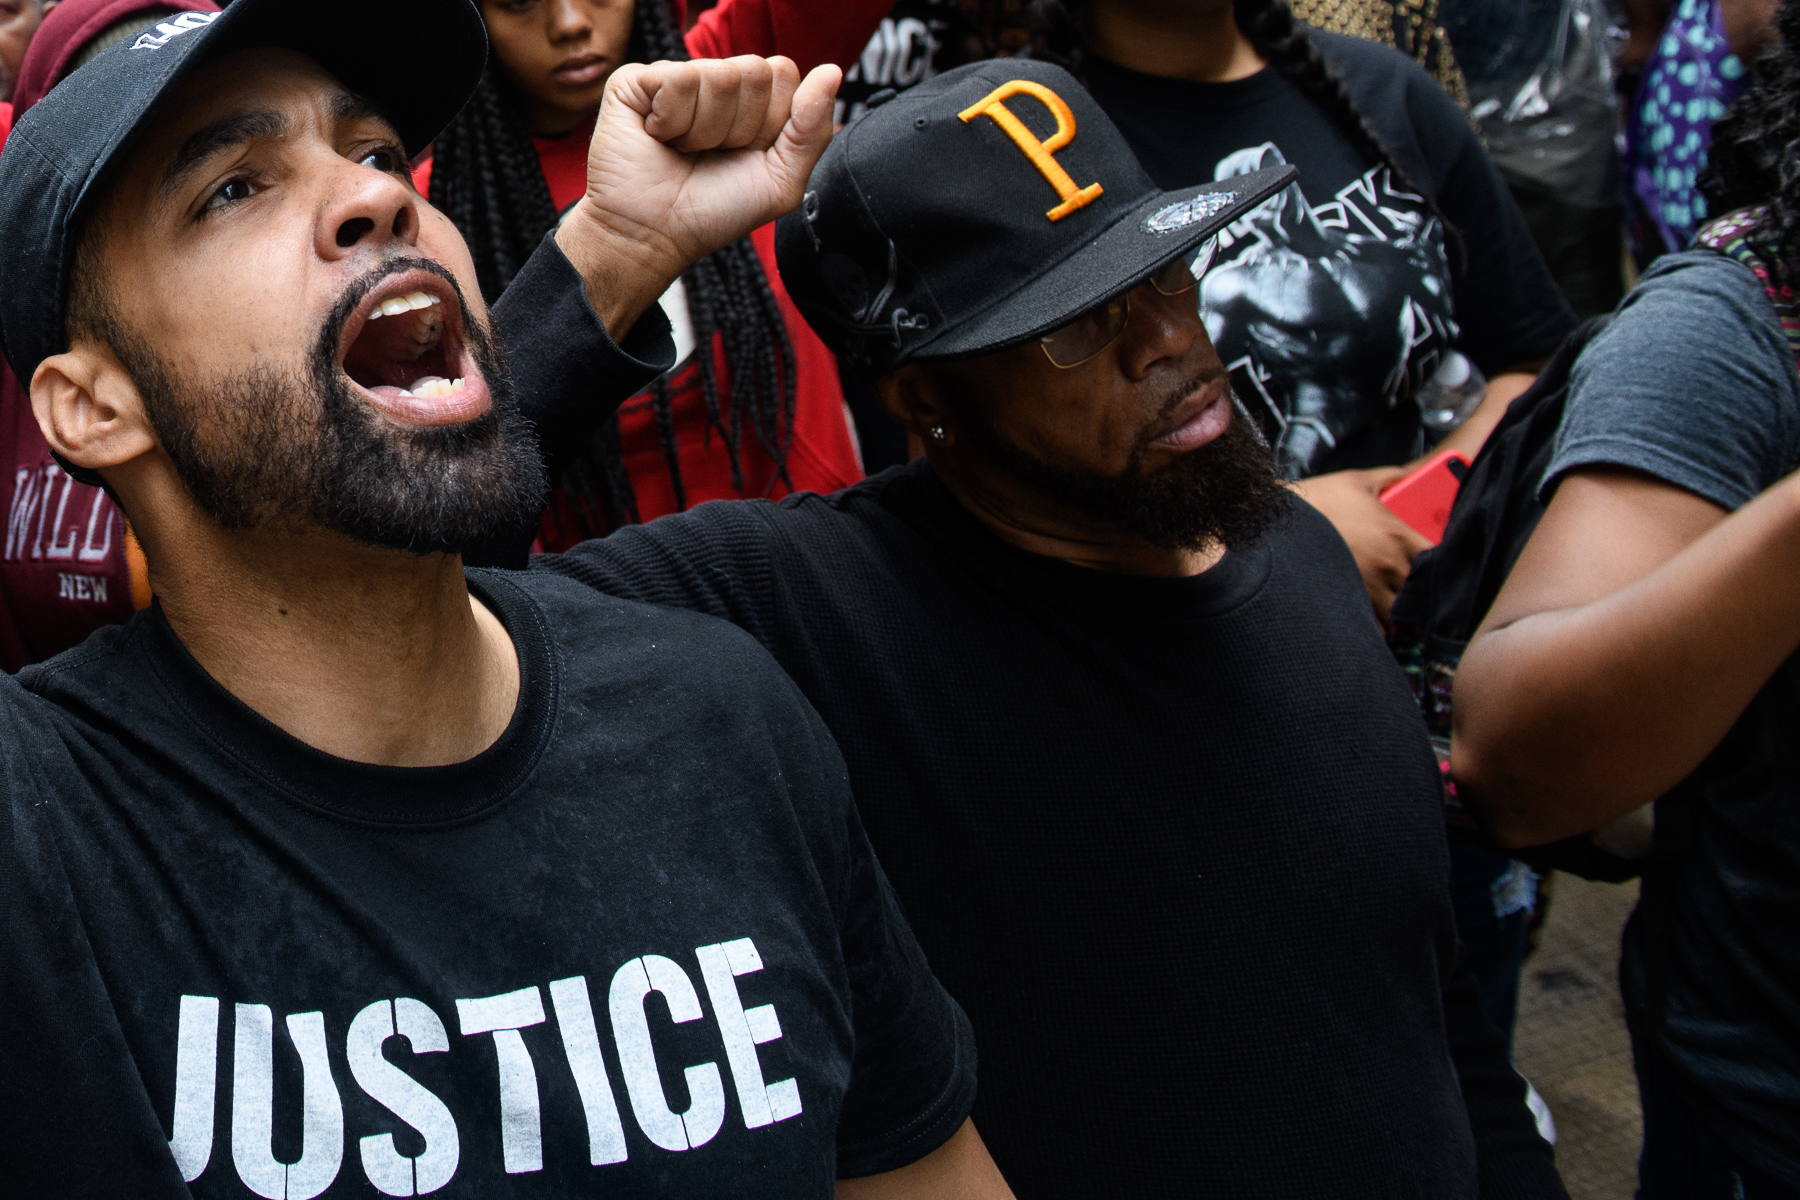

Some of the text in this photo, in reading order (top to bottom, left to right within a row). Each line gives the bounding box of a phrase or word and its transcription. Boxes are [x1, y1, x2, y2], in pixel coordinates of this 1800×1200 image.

[957, 79, 1104, 222] P
[57, 572, 109, 603] NEW
[167, 936, 803, 1200] JUSTICE
